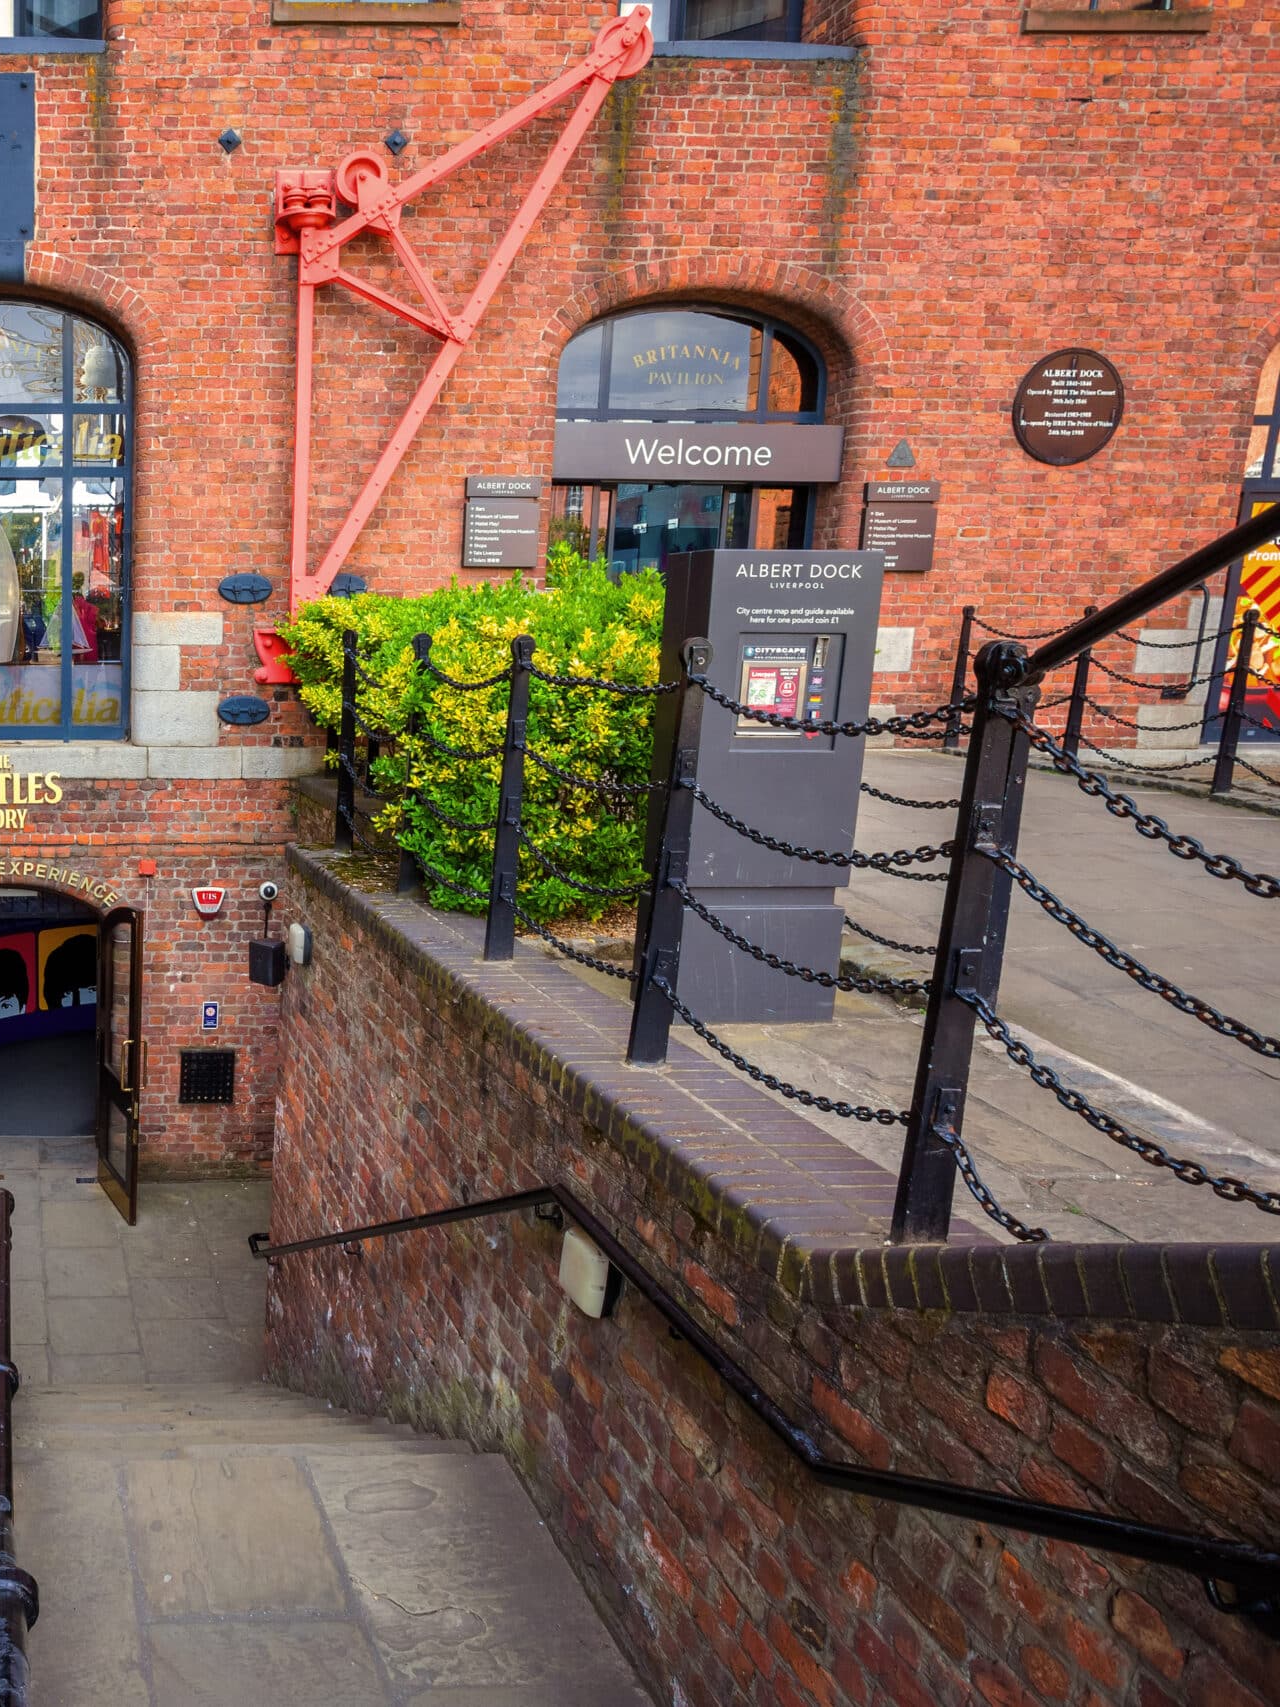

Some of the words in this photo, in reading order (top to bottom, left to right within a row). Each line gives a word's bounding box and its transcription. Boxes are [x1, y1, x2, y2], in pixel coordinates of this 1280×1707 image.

[632, 344, 741, 371] BRITANNIA
[648, 372, 725, 385] PAVILION
[1042, 369, 1077, 377] ALBERT
[1080, 369, 1104, 377] DOCK
[625, 438, 772, 466] Welcome
[476, 482, 506, 490] ALBERT
[508, 482, 531, 490] DOCK
[736, 564, 804, 578] ALBERT
[810, 564, 863, 579] DOCK
[736, 606, 750, 616] City
[774, 608, 789, 616] map
[804, 608, 824, 616] guide
[791, 616, 814, 624] pound
[830, 616, 839, 624] £1
